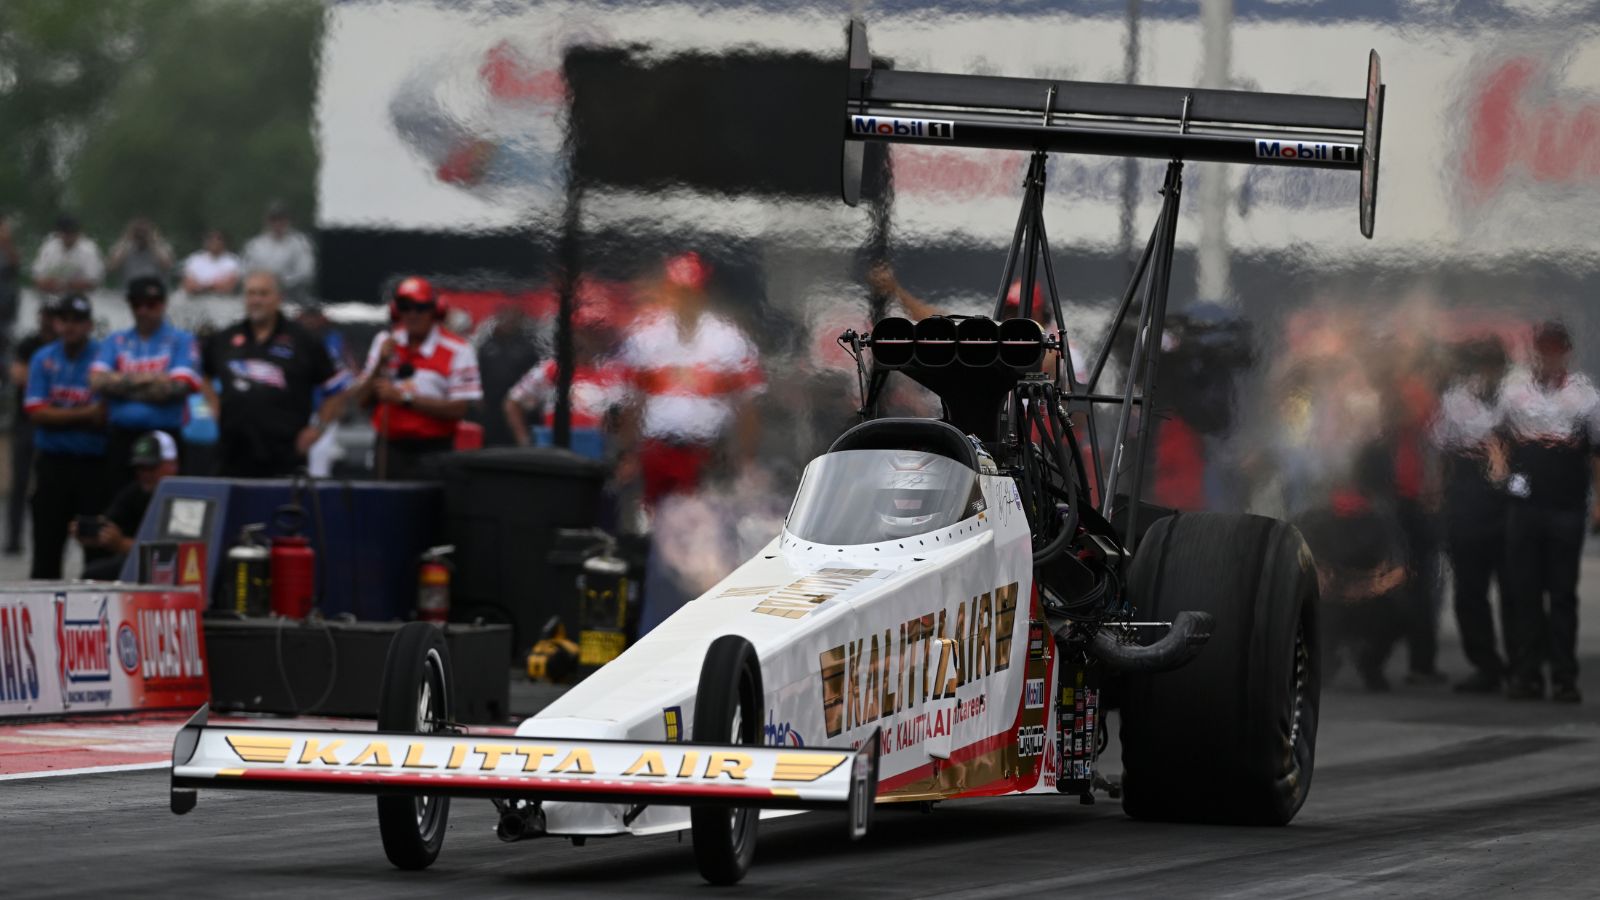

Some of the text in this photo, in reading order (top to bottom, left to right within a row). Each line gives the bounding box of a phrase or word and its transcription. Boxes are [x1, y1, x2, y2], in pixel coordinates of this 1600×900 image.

[855, 117, 946, 137] Mobil 1
[1258, 141, 1350, 160] Mobil 1
[138, 608, 181, 679] LUCAS
[181, 608, 204, 677] OIL
[846, 608, 957, 732] KALITTA
[955, 592, 992, 688] AIR
[1027, 682, 1040, 705] Mobil
[1017, 726, 1046, 757] DAYCO
[297, 739, 596, 774] KALITTA
[621, 751, 753, 780] AIR
[1044, 775, 1056, 787] TOOLS
